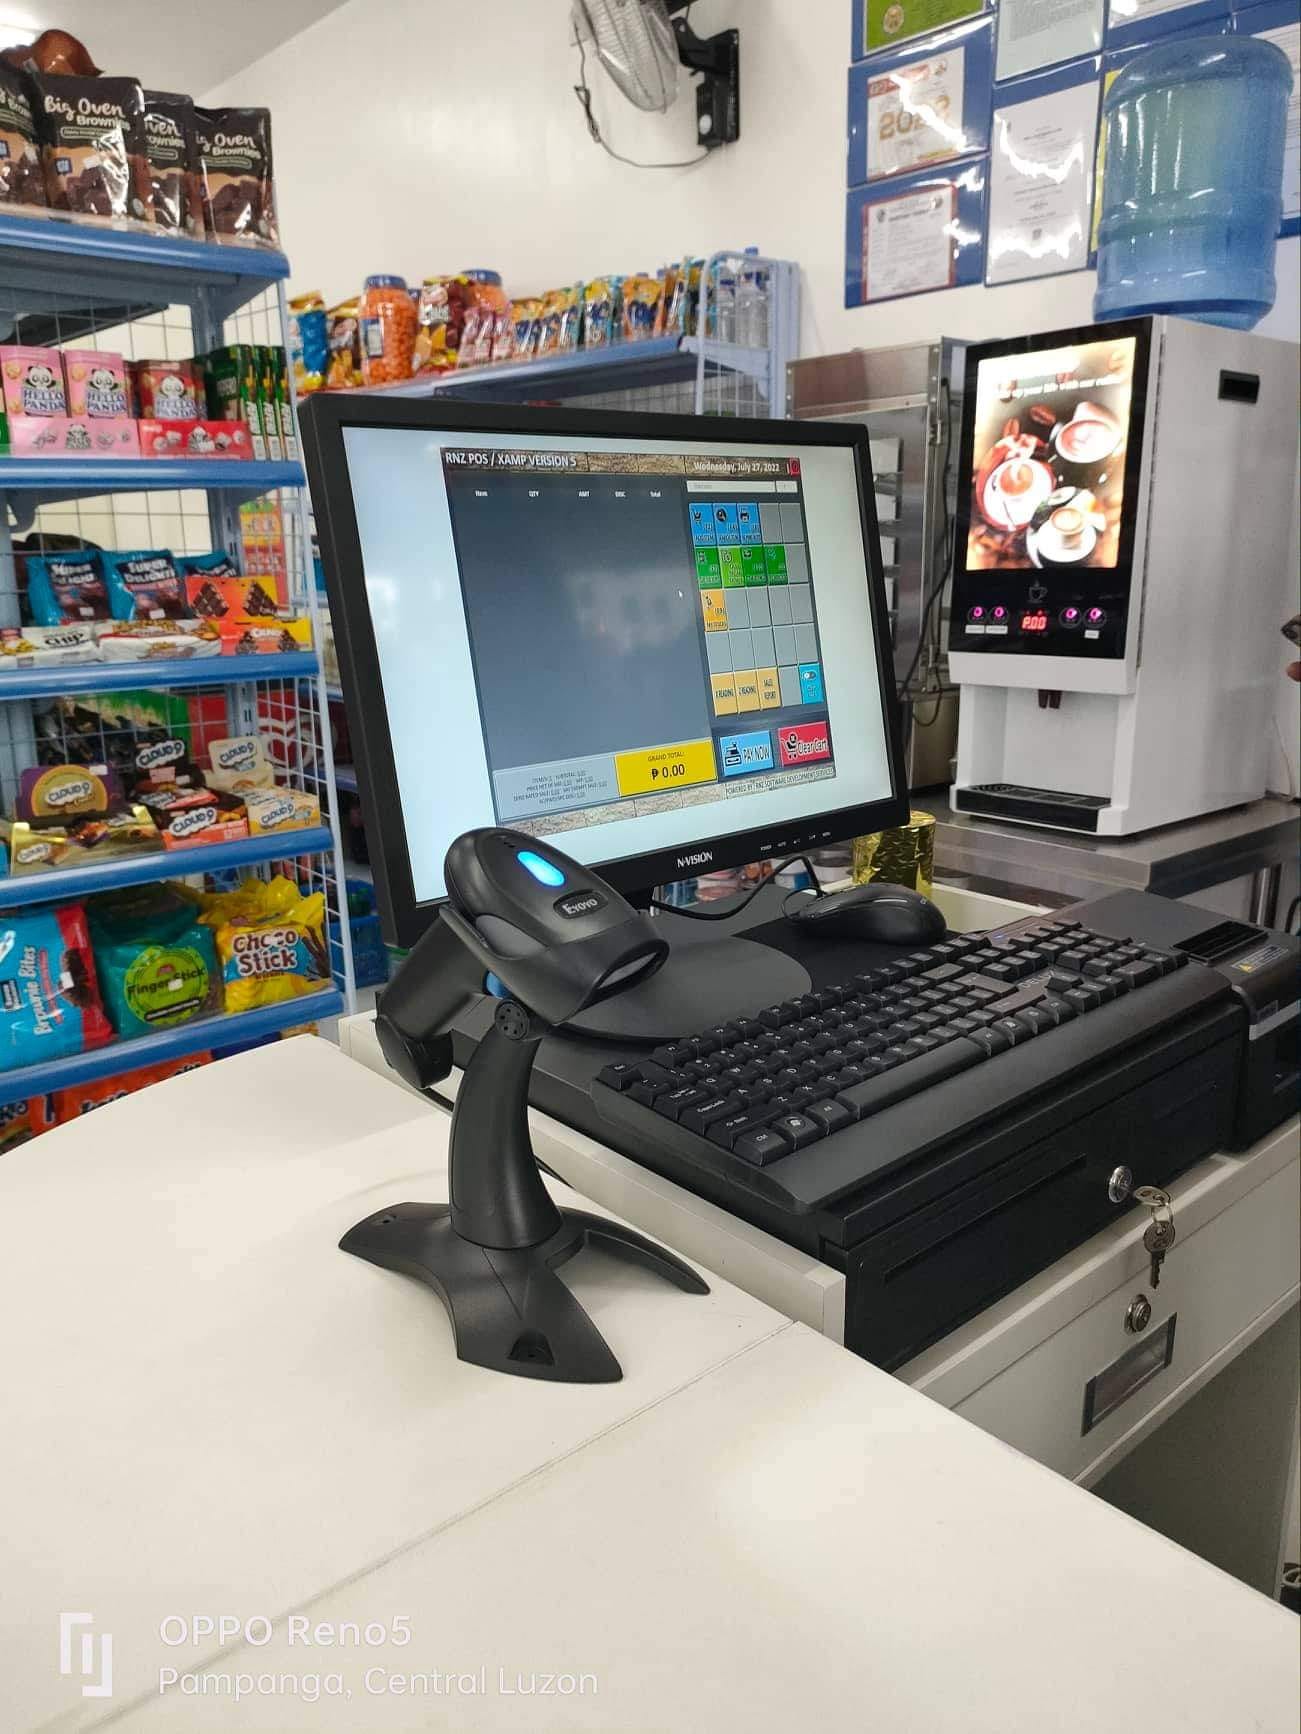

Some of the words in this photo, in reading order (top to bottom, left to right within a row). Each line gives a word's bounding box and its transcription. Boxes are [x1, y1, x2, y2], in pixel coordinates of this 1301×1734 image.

[44, 95, 75, 121] Big
[78, 98, 125, 118] Oven
[214, 133, 257, 149] Oven
[24, 389, 64, 400] HELLO
[87, 391, 125, 402] HELLO
[24, 399, 66, 411] PANDA
[88, 401, 126, 412] PANDA
[446, 452, 466, 464] RNZ
[468, 453, 489, 465] POS
[497, 453, 527, 466] XAMP
[528, 454, 569, 467] VERSION
[694, 461, 737, 473] Wednesday,
[737, 461, 751, 473] July
[764, 463, 780, 472] 2022
[140, 745, 173, 766] CLOUD
[174, 742, 182, 755] 9
[220, 745, 248, 763] CLOUD
[247, 742, 254, 753] 9
[647, 754, 666, 762] GRAND
[742, 747, 753, 763] PAY
[755, 744, 770, 760] NOW
[662, 763, 685, 778] 0.00
[48, 786, 81, 802] CLOUD
[82, 782, 90, 794] 9
[173, 813, 206, 833] CLOUD
[207, 809, 215, 820] 9
[261, 807, 288, 824] CLOUD
[287, 803, 294, 814] 9
[18, 945, 37, 978] Bites
[238, 949, 296, 974] Stick
